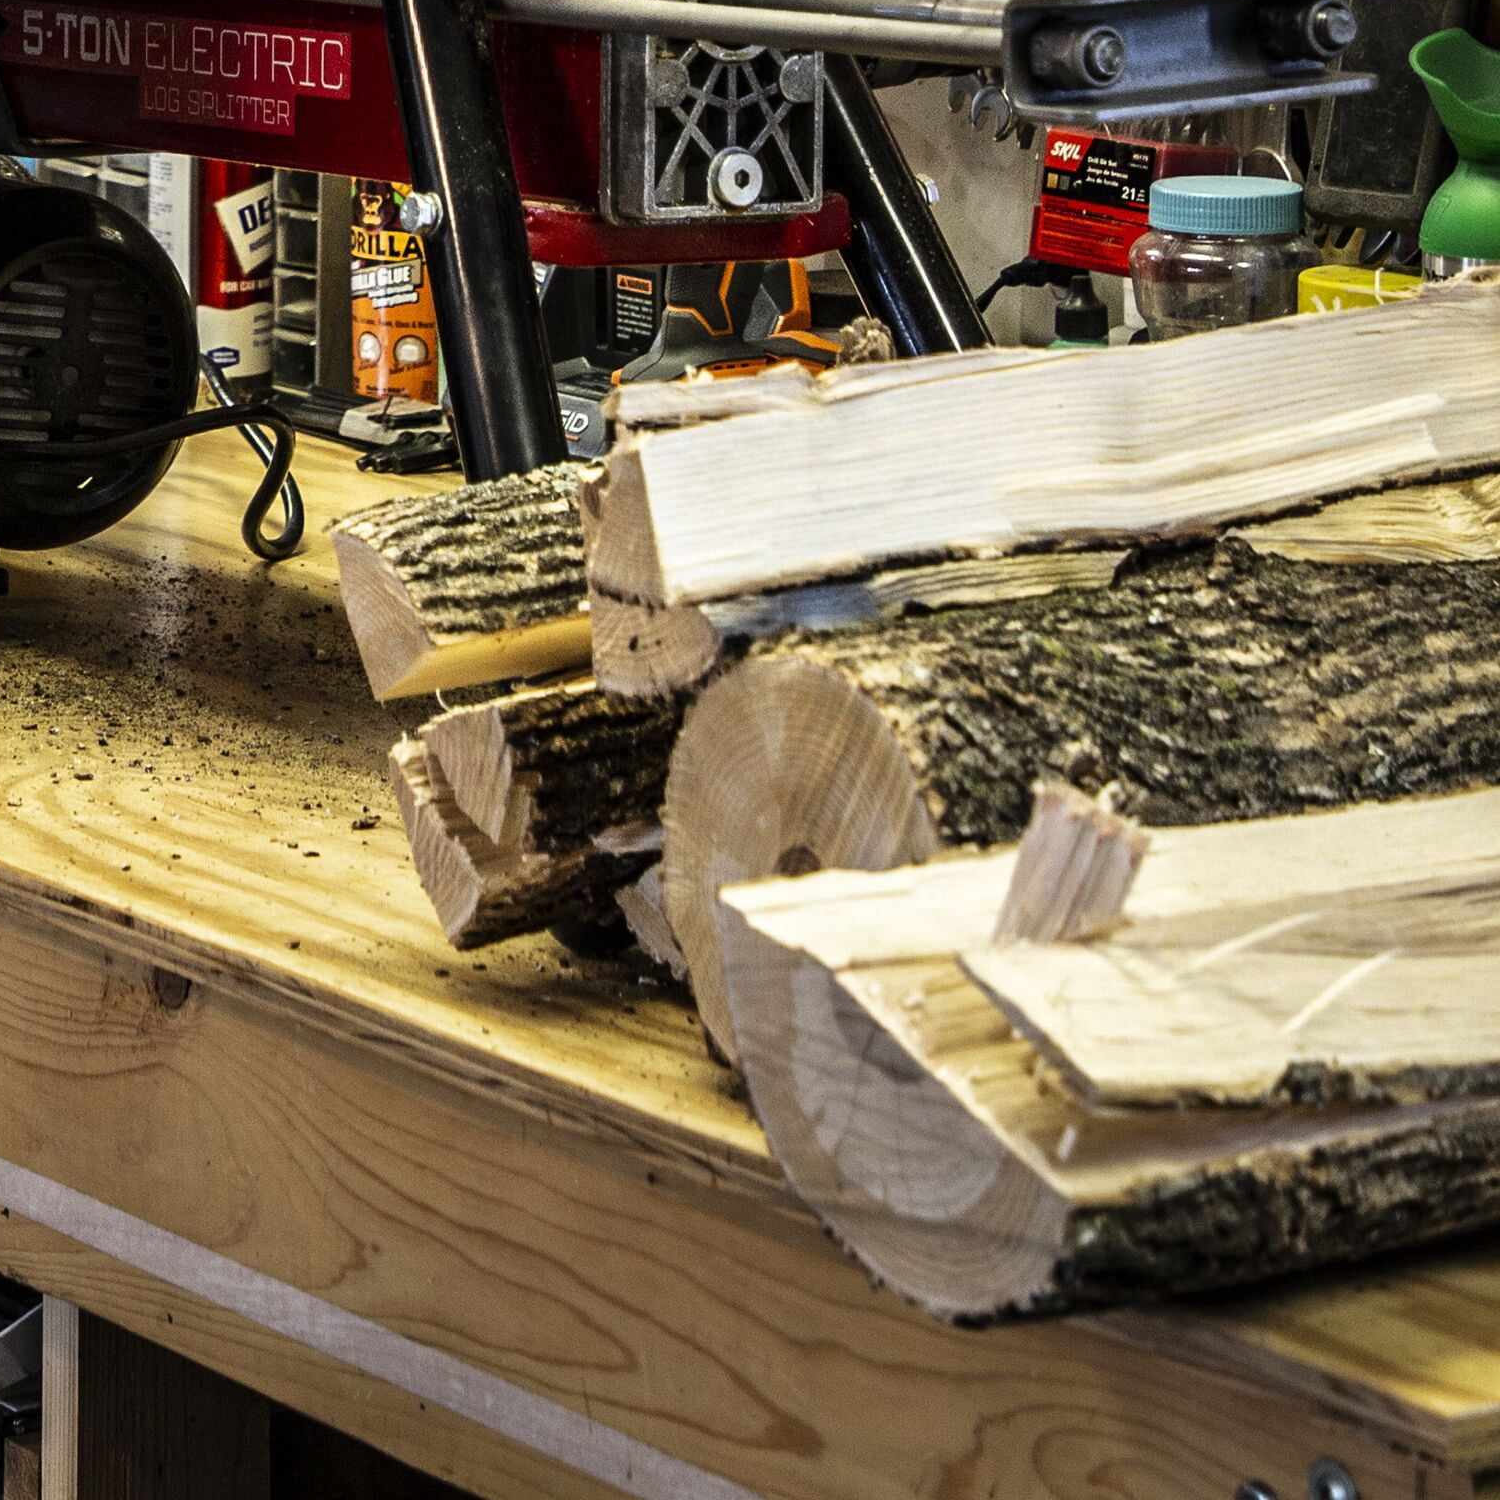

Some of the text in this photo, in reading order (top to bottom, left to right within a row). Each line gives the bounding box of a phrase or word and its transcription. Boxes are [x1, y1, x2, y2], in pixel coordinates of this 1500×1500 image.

[144, 21, 345, 91] ELECTRIC
[143, 85, 291, 127] LOG SPLITTER
[1050, 140, 1082, 163] SKIL
[1120, 185, 1136, 201] 21
[376, 264, 412, 288] GLUE
